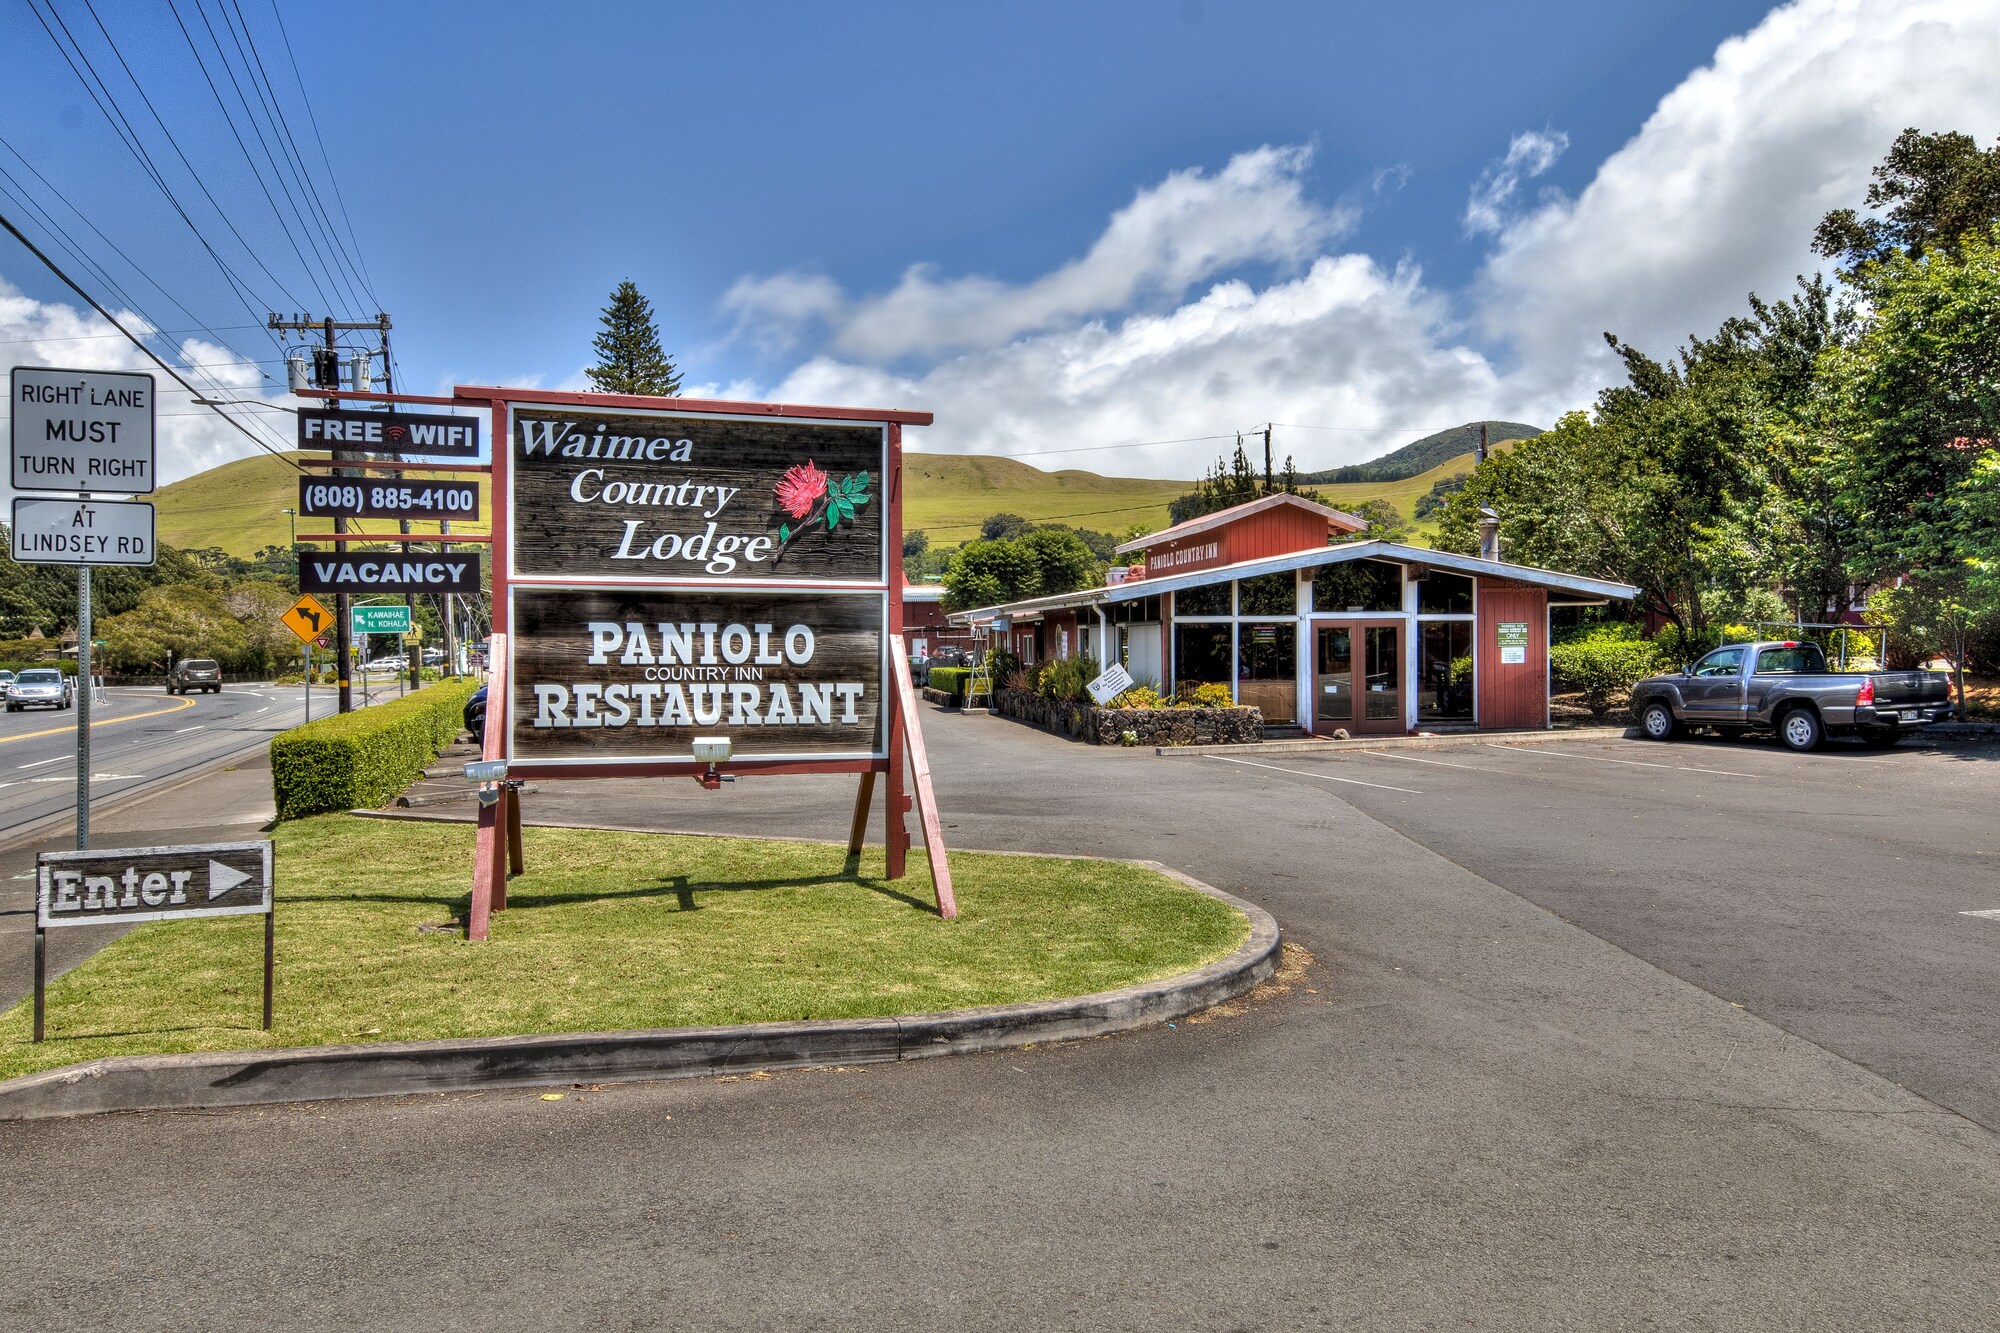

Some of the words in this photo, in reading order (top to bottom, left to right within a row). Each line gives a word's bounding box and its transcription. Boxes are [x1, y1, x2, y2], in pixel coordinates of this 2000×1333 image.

[22, 385, 82, 404] RIGHT
[91, 388, 144, 408] LANE
[46, 419, 121, 443] MUST
[305, 419, 382, 442] FREE
[409, 424, 473, 447] WIFI
[519, 419, 694, 462] Waimea
[20, 456, 75, 474] TURN
[88, 458, 147, 477] RIGHT
[306, 485, 363, 513] (808)
[371, 487, 473, 511] 885-4100
[570, 468, 741, 519] Country
[72, 510, 96, 528] AT
[21, 533, 109, 553] LINDSEY
[118, 536, 146, 554] RD.
[610, 519, 773, 575] Lodge
[1150, 552, 1175, 570] PANIOLO
[1175, 545, 1205, 566] COUNTRY
[1205, 542, 1218, 559] INN
[314, 562, 467, 584] VACANCY
[367, 611, 405, 619] KAWAIHAE
[368, 620, 376, 628] N.
[378, 620, 408, 628] KOHALA
[588, 622, 815, 666] PANIOLO
[644, 667, 731, 681] COUNTRY
[735, 667, 763, 681] INN
[533, 683, 863, 727] RESTAURANT
[52, 866, 192, 911] Enter
